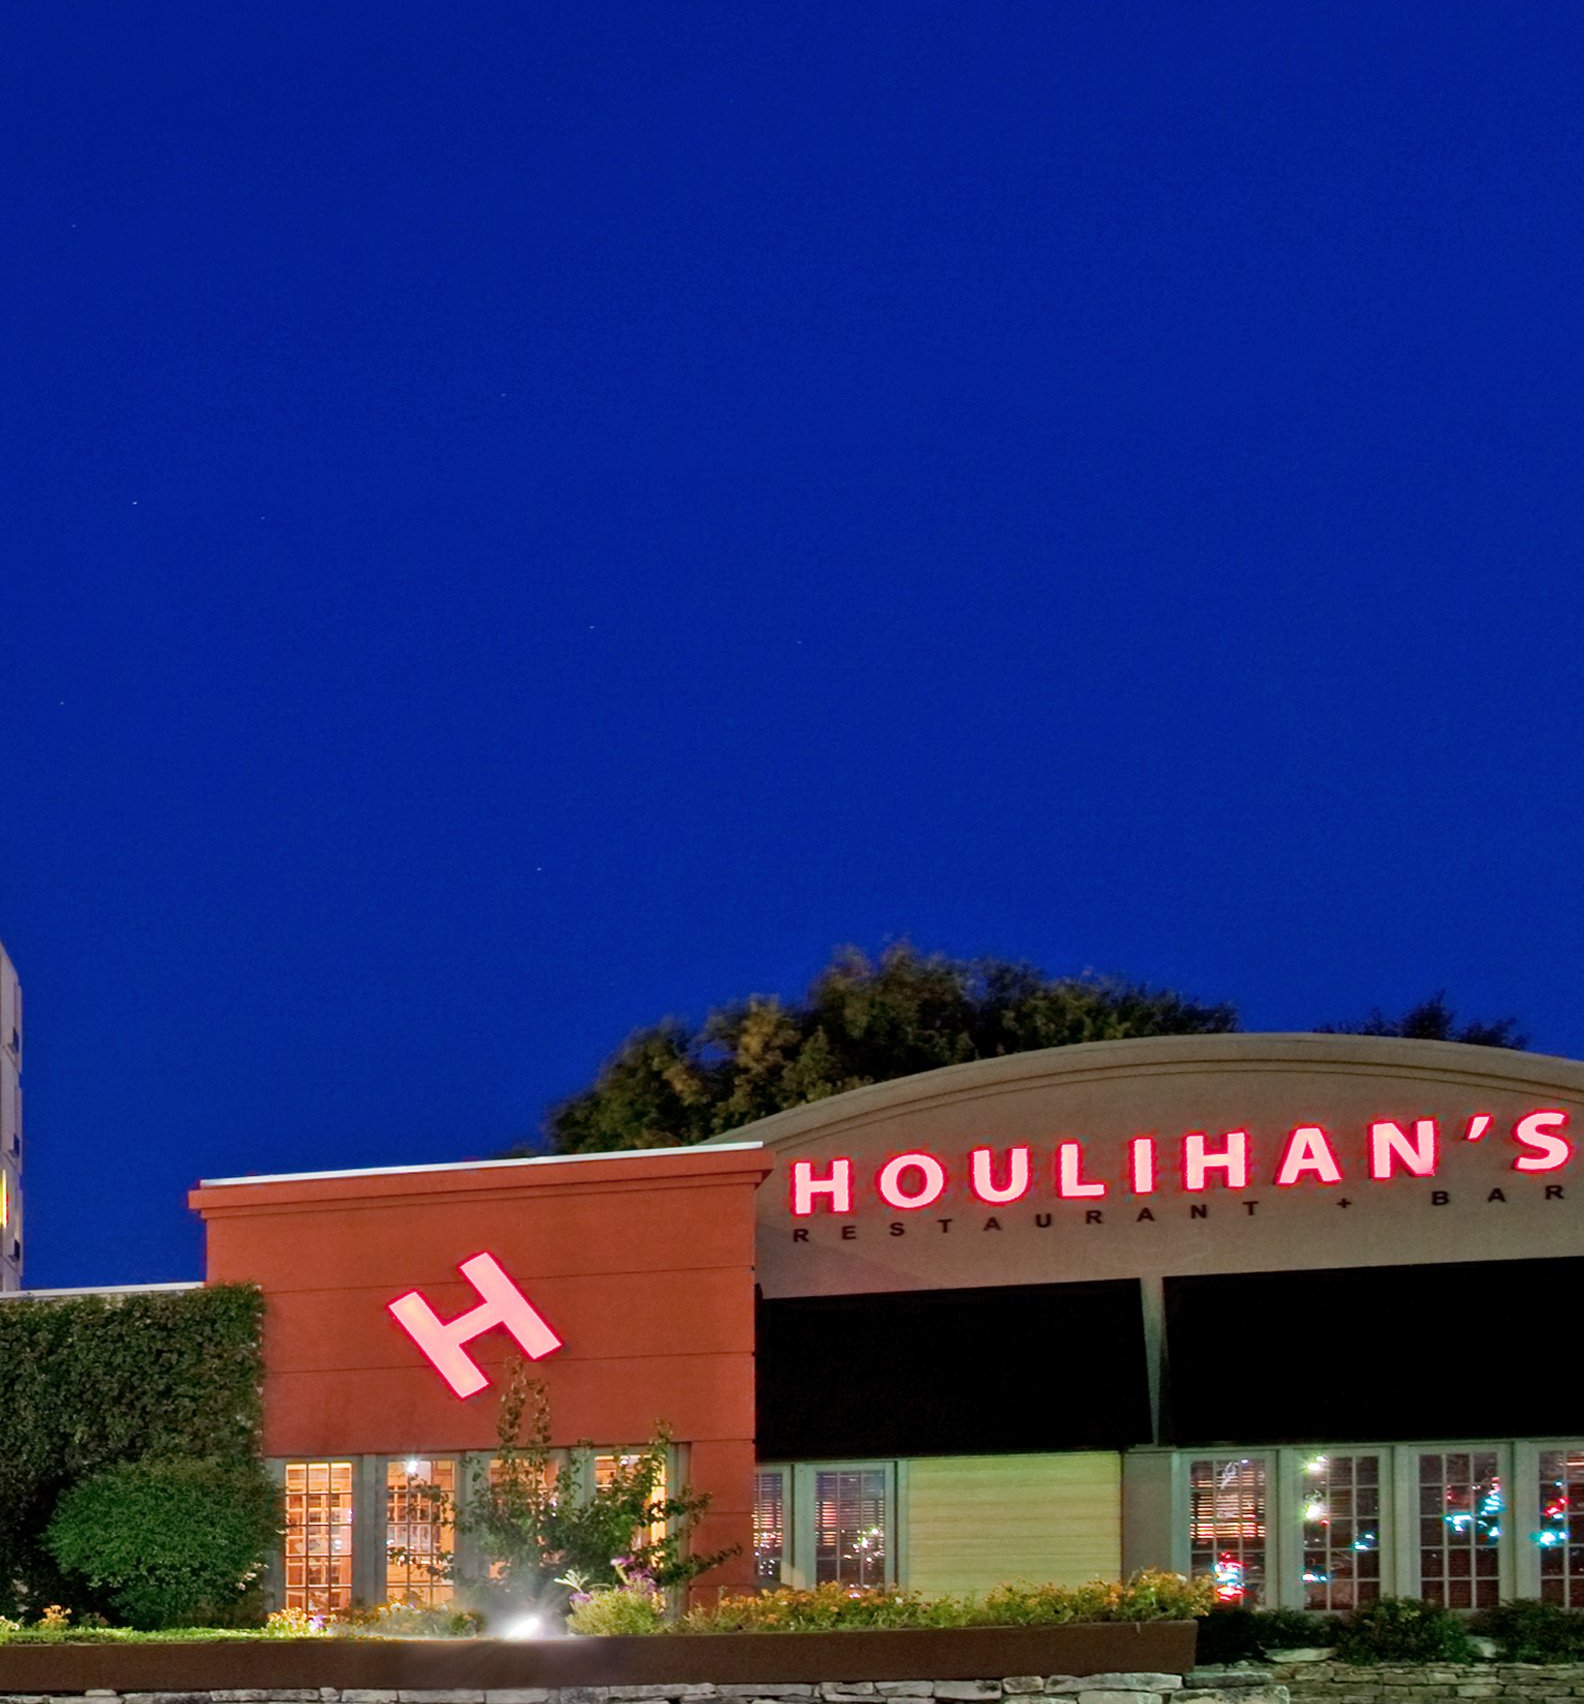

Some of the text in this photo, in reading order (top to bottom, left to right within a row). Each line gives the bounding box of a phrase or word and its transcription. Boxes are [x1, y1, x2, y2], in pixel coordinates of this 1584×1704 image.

[792, 1110, 1571, 1216] HOULIHAN'S
[792, 1200, 1260, 1243] RESTAURANT
[1431, 1184, 1565, 1206] BAR
[385, 1250, 564, 1401] H
